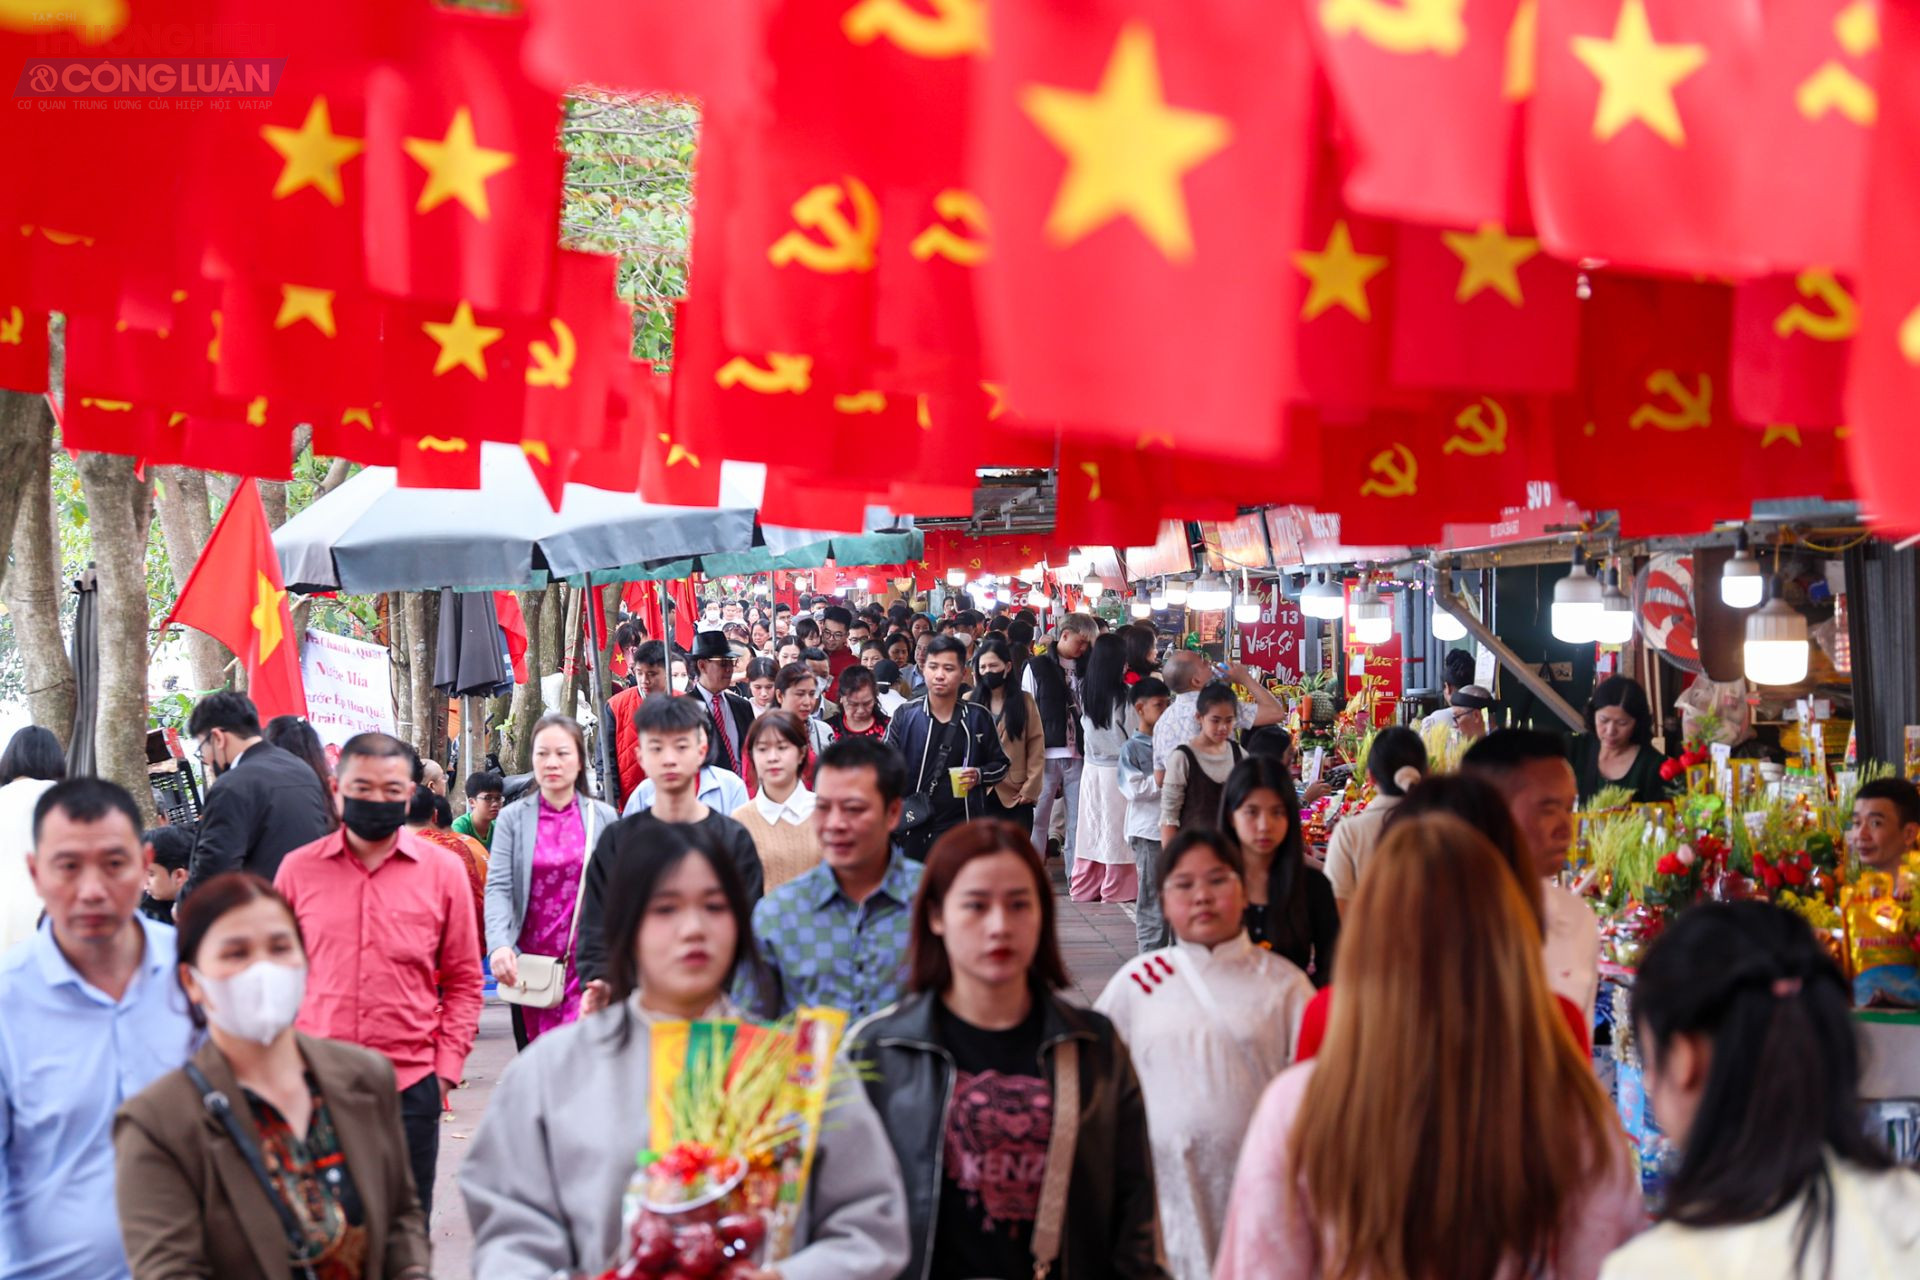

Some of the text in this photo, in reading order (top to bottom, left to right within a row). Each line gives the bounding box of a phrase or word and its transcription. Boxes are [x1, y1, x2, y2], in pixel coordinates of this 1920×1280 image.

[1281, 611, 1298, 624] 13
[1246, 627, 1276, 657] Viết
[963, 1151, 1049, 1183] KENZ
